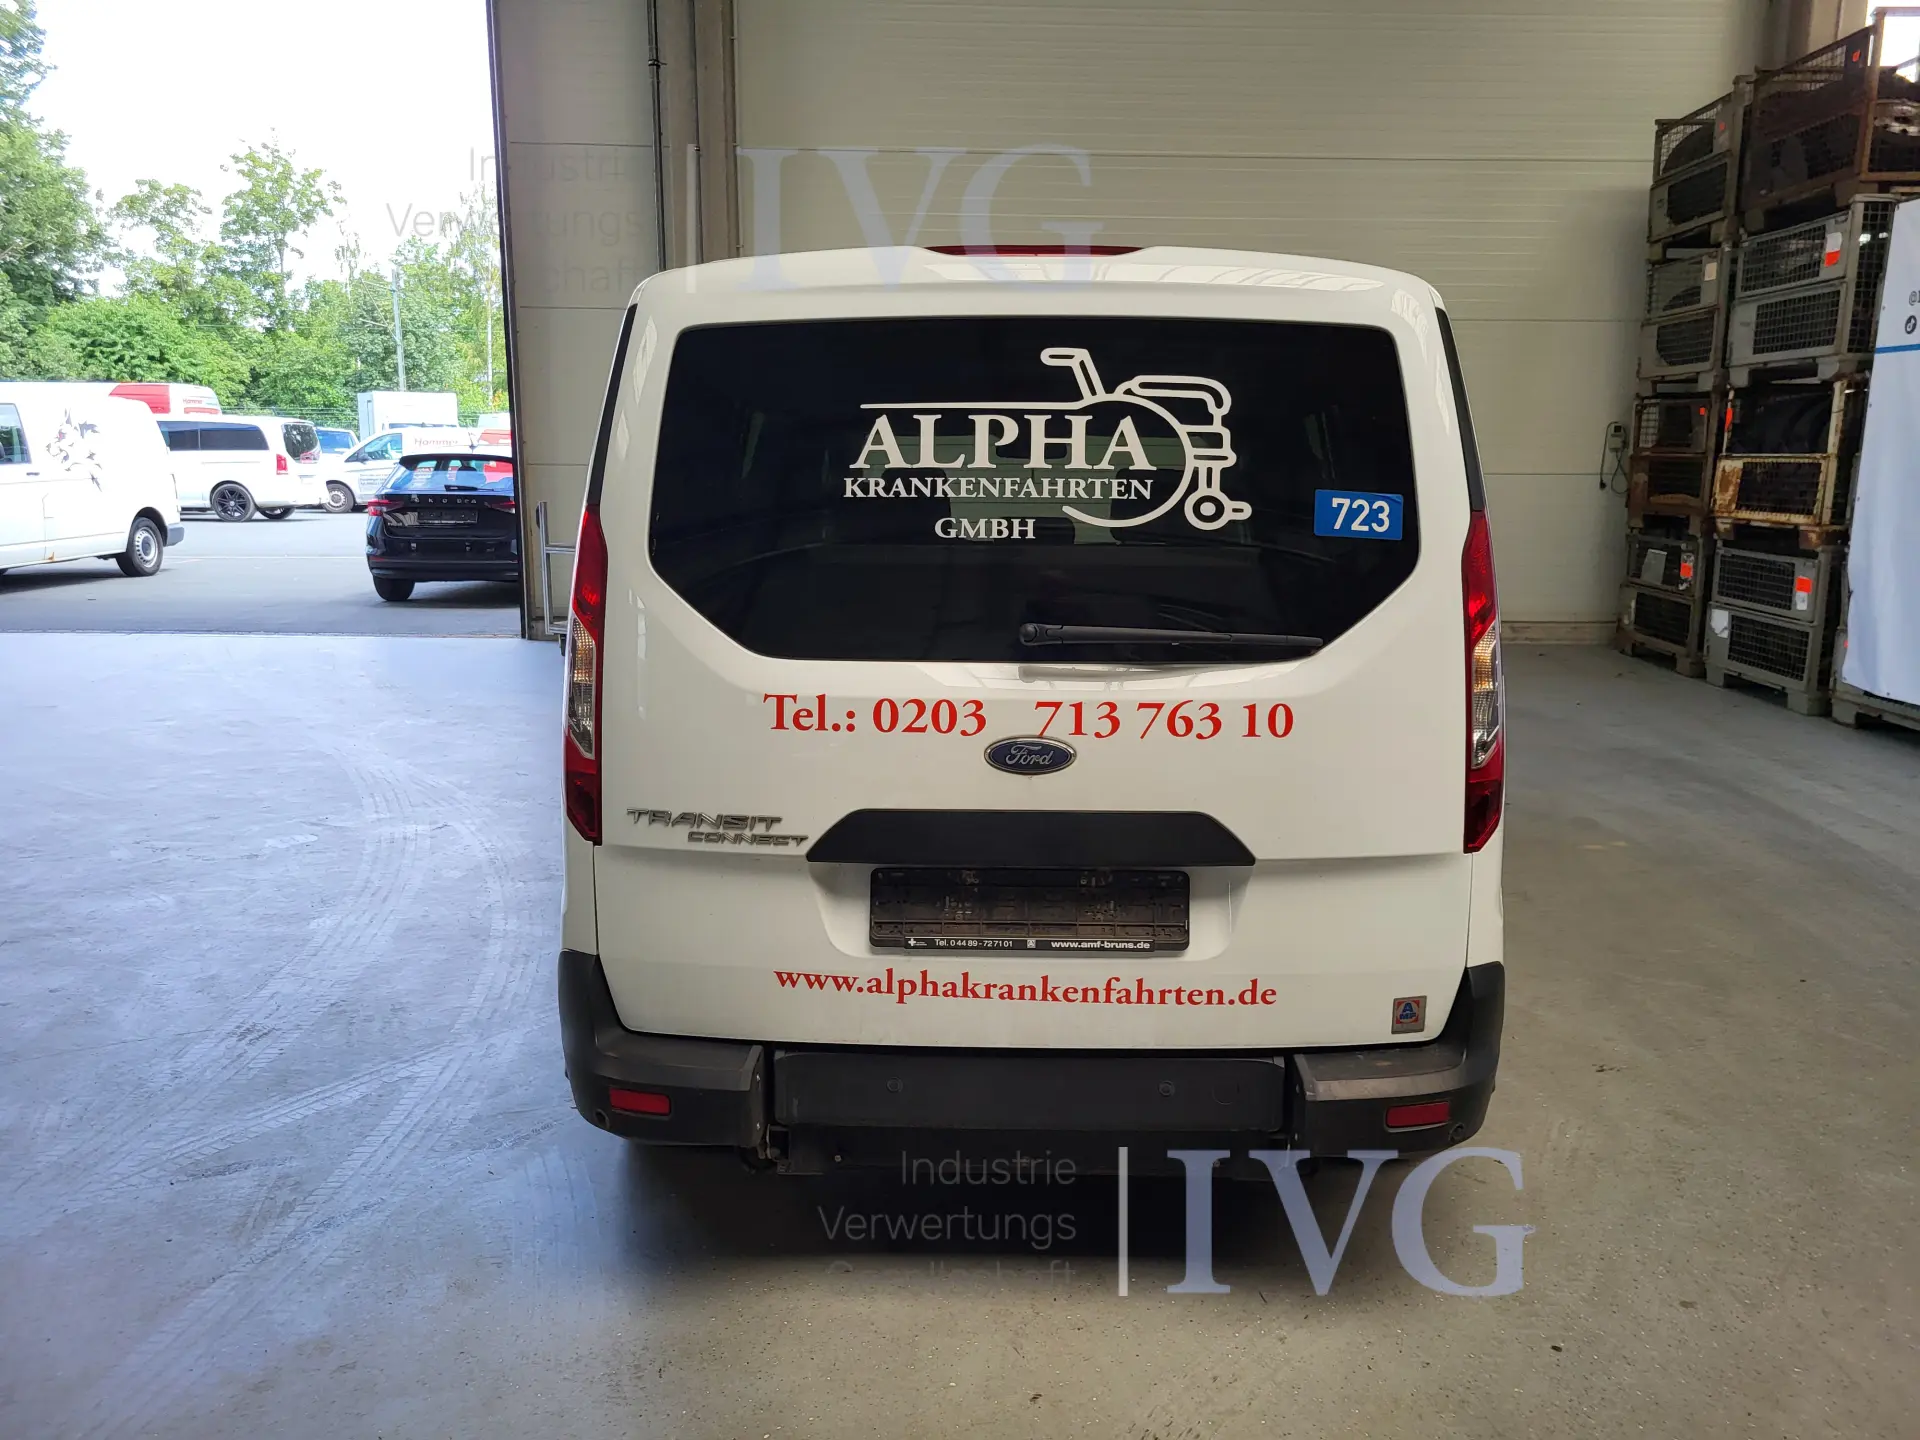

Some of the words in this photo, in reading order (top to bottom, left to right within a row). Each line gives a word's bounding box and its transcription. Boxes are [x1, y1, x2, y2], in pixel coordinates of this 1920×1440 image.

[849, 414, 1157, 471] ALPHA
[843, 477, 1154, 501] KRANKENFAHRTEN
[1332, 497, 1390, 532] 723
[934, 517, 1036, 540] GMBH
[763, 693, 857, 732] Tel.:
[872, 698, 988, 737] 0203
[1033, 700, 1121, 739] 713
[1136, 700, 1223, 740] 763
[1242, 702, 1294, 739] 10
[1005, 744, 1055, 765] Ford
[626, 807, 783, 832] TRANSIT
[687, 831, 809, 847] CONNECT
[934, 939, 949, 947] Tel.
[1051, 941, 1150, 949] www.amf-bruns.de
[773, 968, 1277, 1005] www.alphakrankenfahrten.de
